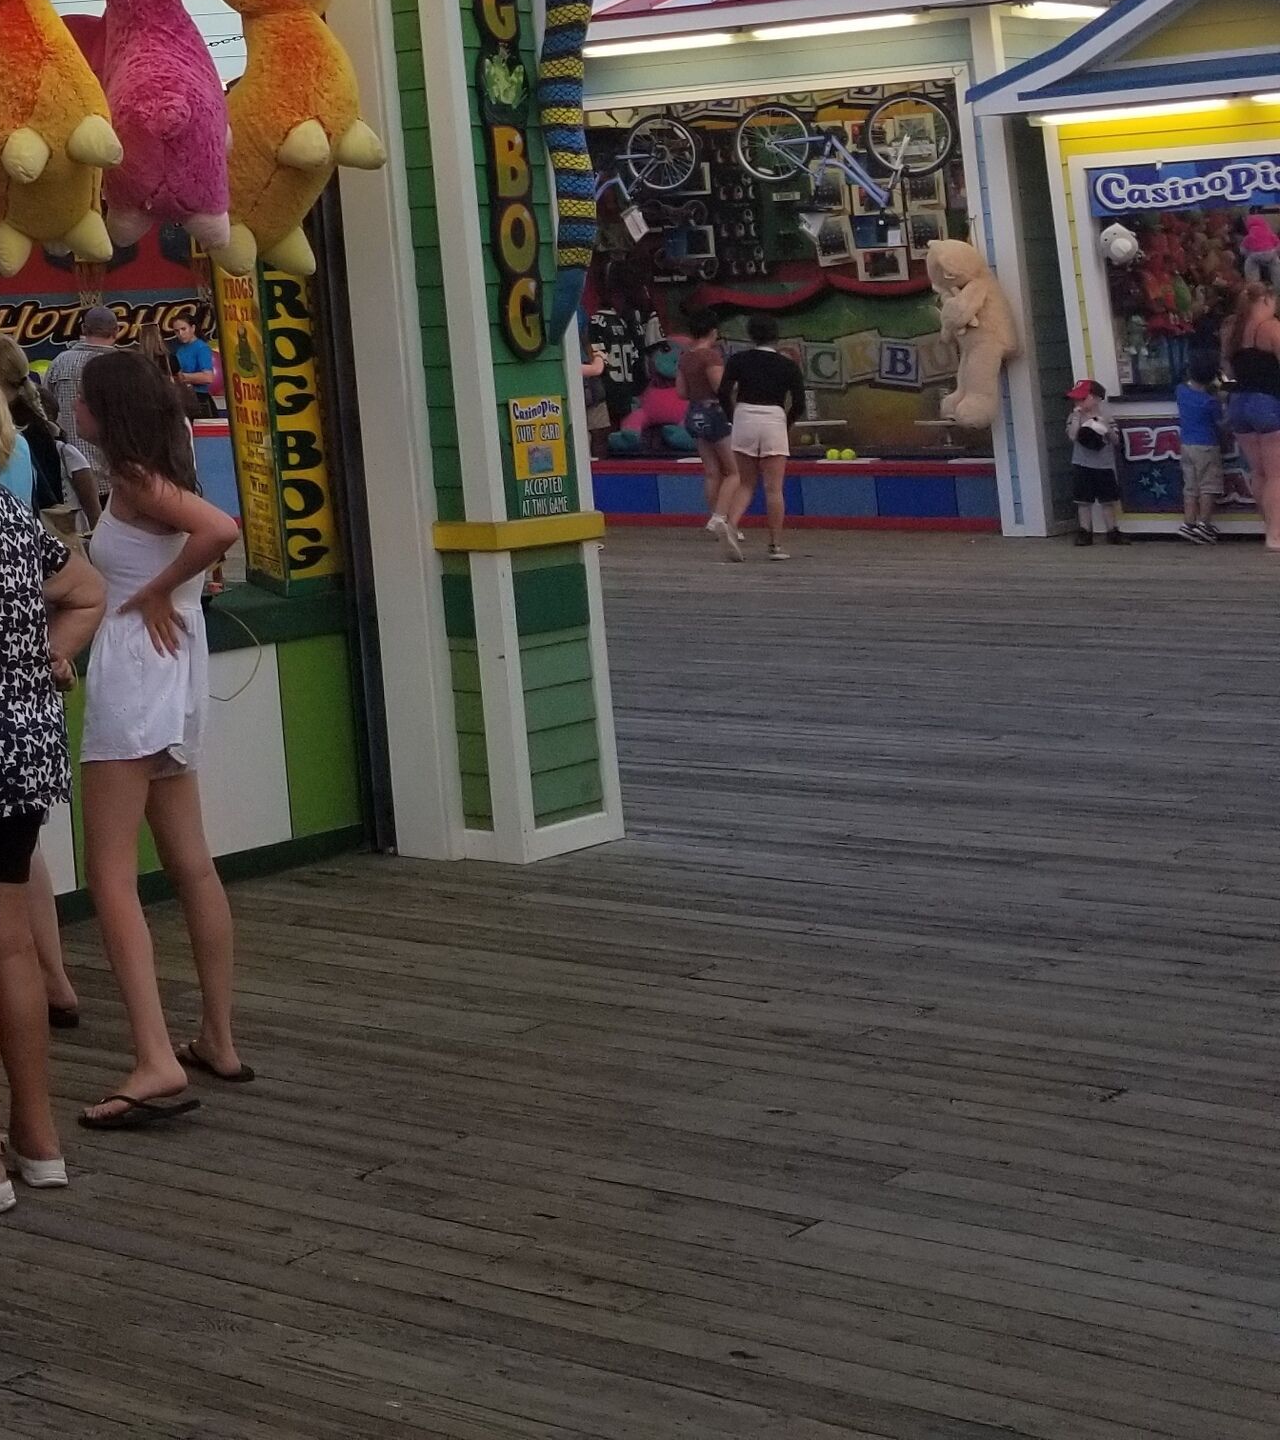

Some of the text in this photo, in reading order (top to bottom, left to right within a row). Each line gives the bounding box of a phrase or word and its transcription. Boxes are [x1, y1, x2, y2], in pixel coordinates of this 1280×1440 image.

[493, 125, 542, 352] BOG
[223, 278, 254, 299] FROGS
[232, 372, 265, 405] 8 FROGS
[235, 405, 248, 425] FOR
[516, 423, 560, 443] SURF CARD
[525, 477, 562, 496] ACCEPTED
[276, 430, 329, 570] BOG
[522, 496, 568, 517] AT THIS GAME
